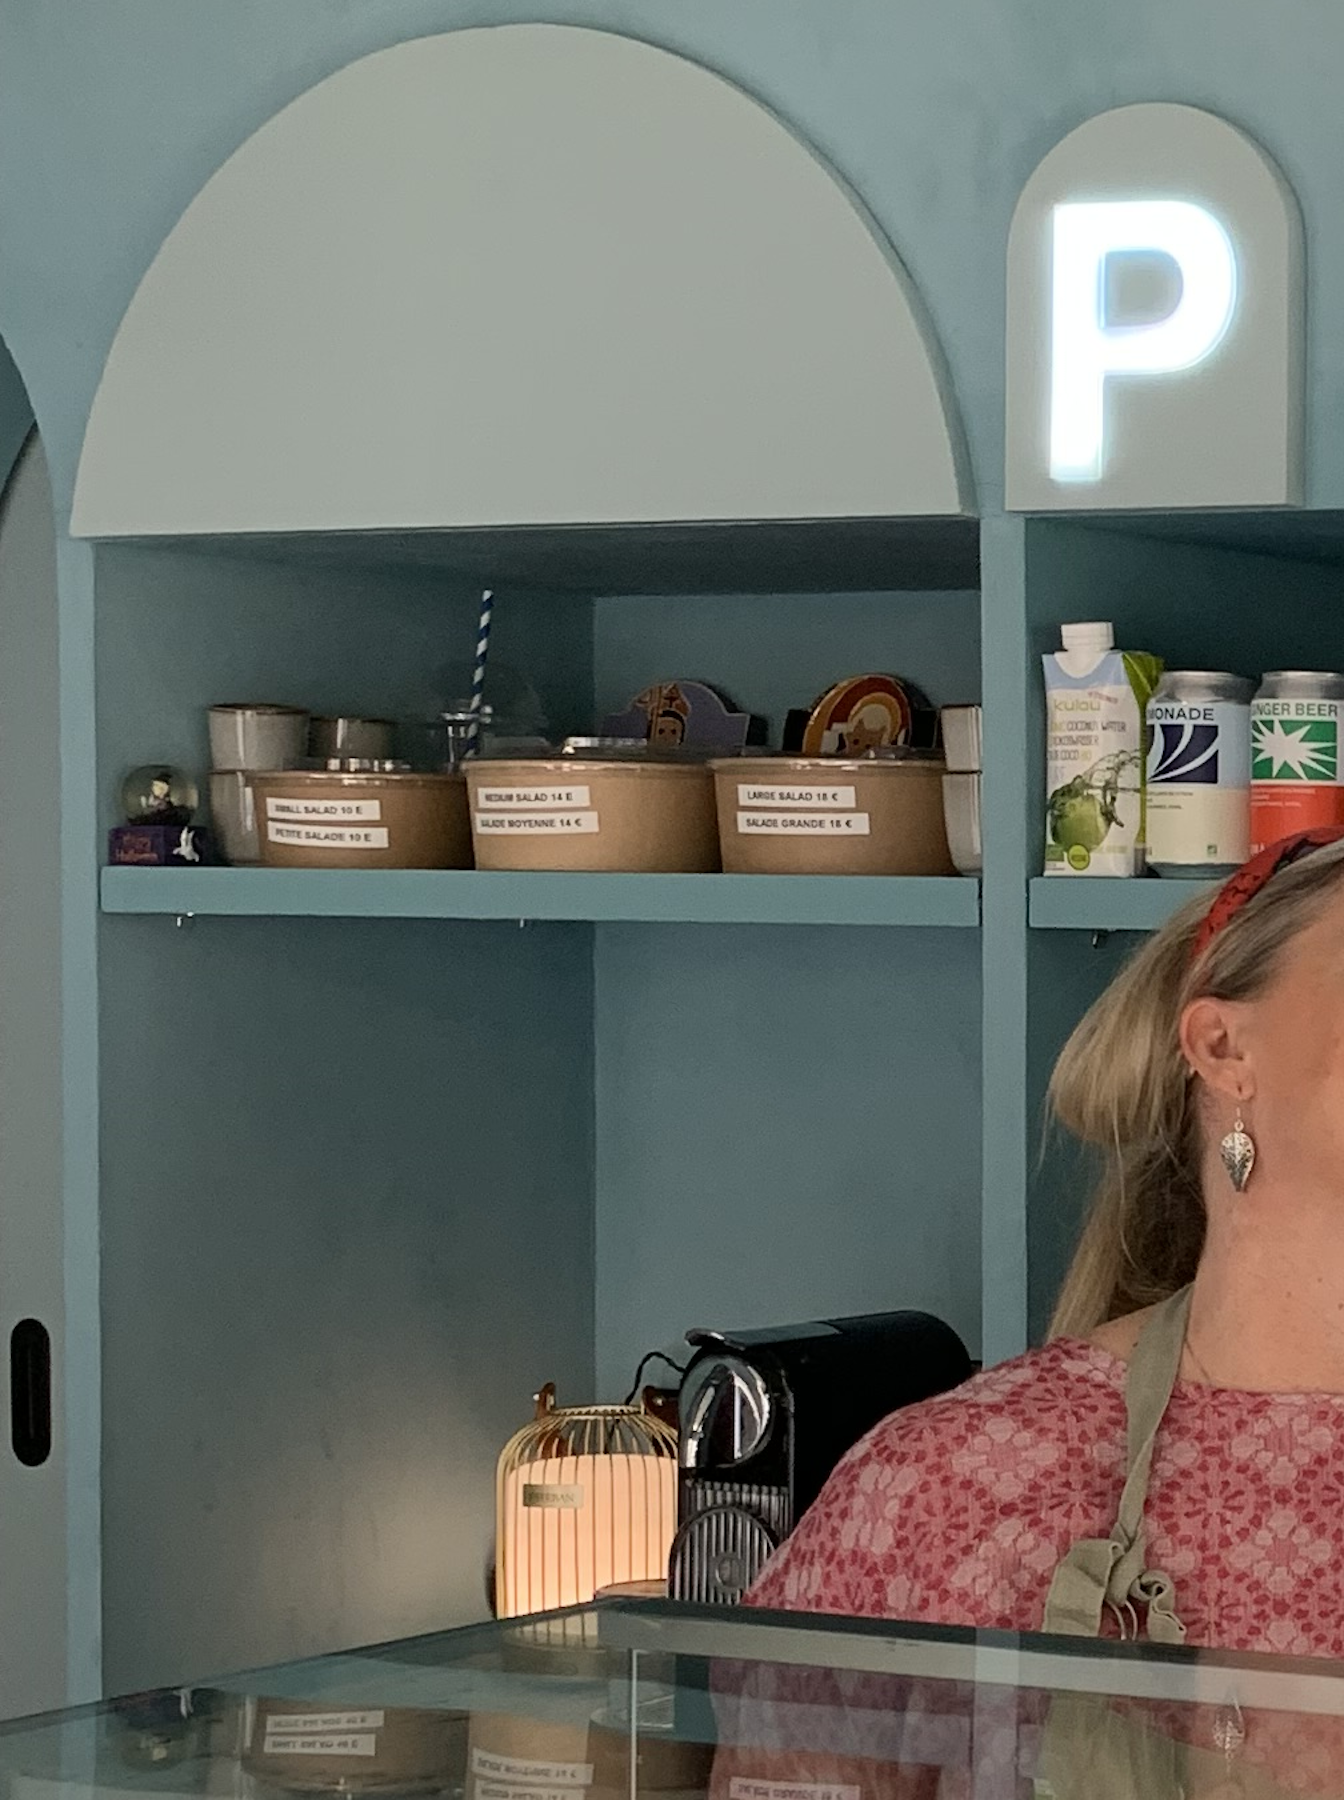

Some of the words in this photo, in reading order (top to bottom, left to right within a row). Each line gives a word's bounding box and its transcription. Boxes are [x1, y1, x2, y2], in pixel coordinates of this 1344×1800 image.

[1054, 699, 1101, 712] kulau
[1295, 703, 1338, 717] BEER
[1148, 708, 1214, 721] MONADE
[516, 793, 548, 802] SALAD
[747, 790, 776, 800] LARGE
[778, 791, 813, 801] SALAD
[304, 806, 337, 815] SALAD
[341, 806, 353, 815] 10
[508, 819, 555, 829] MOYENNE
[746, 818, 778, 828] SALADE
[782, 819, 825, 828] GRANDE
[305, 831, 345, 842] SALADE
[349, 833, 361, 842] 10
